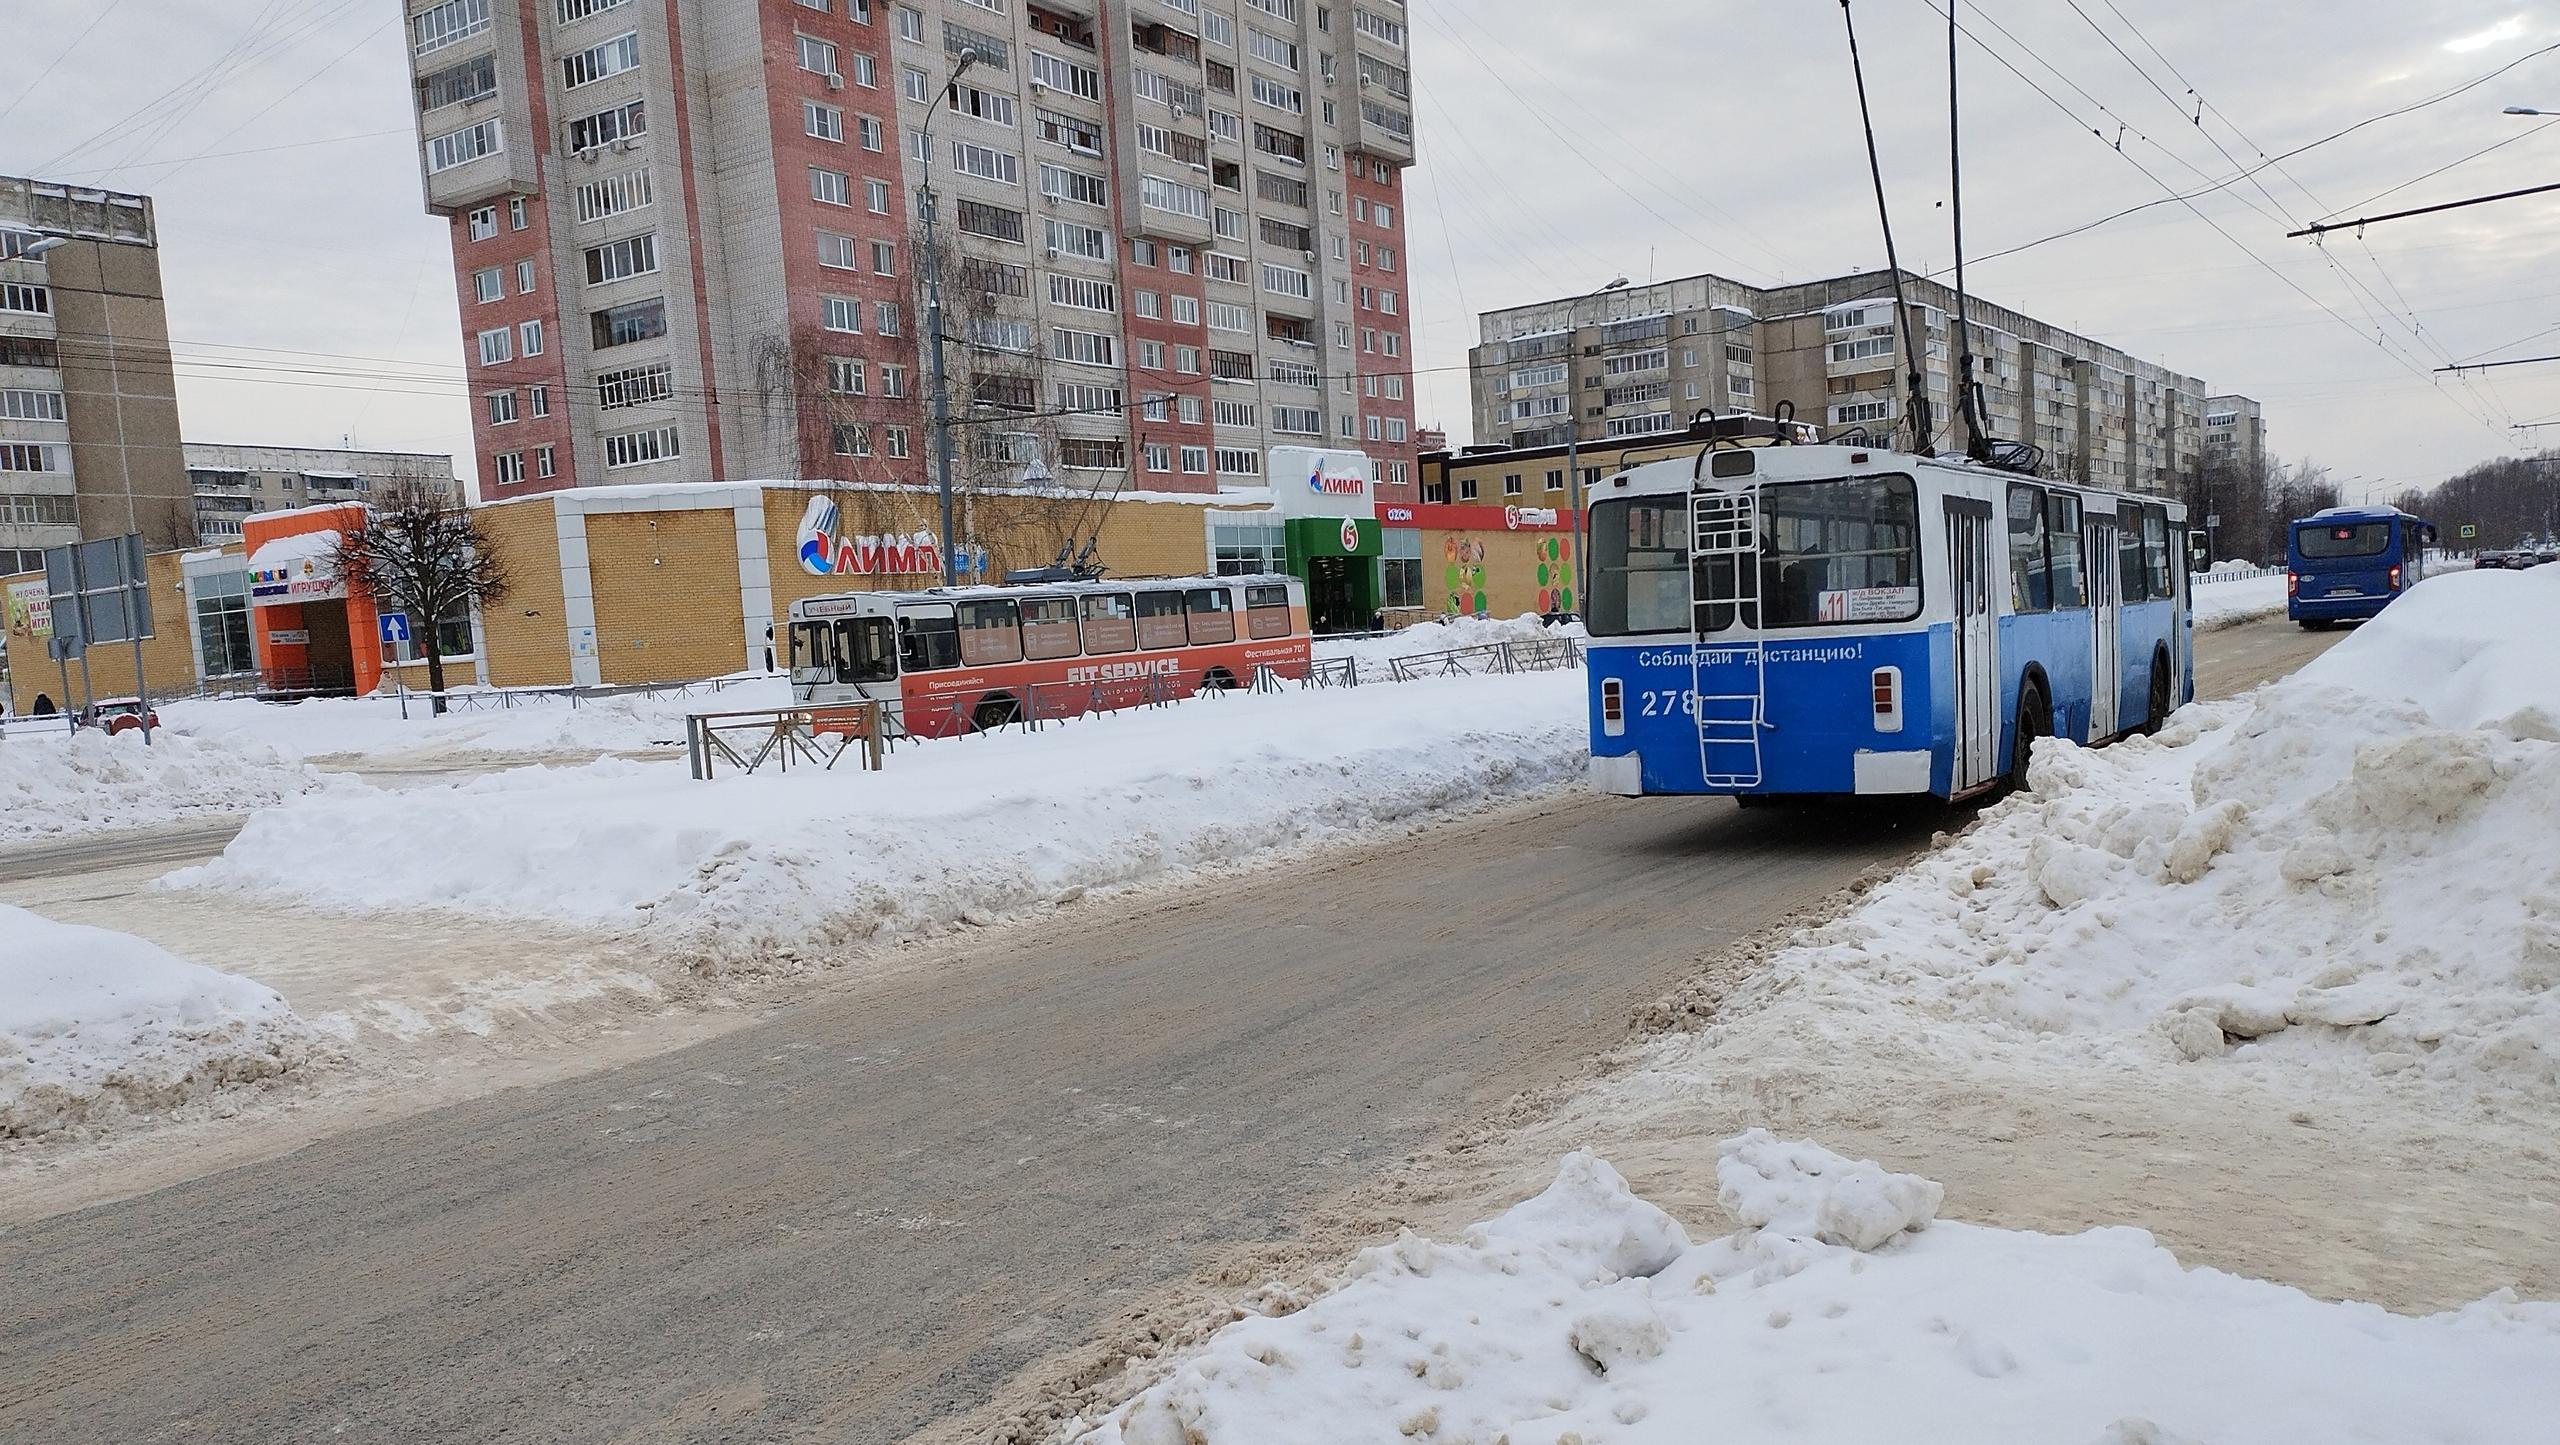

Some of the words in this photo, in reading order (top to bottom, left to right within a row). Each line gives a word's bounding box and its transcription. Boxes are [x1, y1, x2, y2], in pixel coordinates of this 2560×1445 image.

[1868, 587, 1904, 596] ВОКЗАЛ
[808, 603, 852, 614] УЧЕБНЫЙ
[1828, 593, 1844, 621] 11
[1244, 647, 1293, 658] Фестивальная
[1067, 665, 1099, 687] FIT
[1100, 657, 1180, 684] SERVICE
[929, 677, 985, 691] Присоединяйся
[1641, 689, 1696, 717] 278
